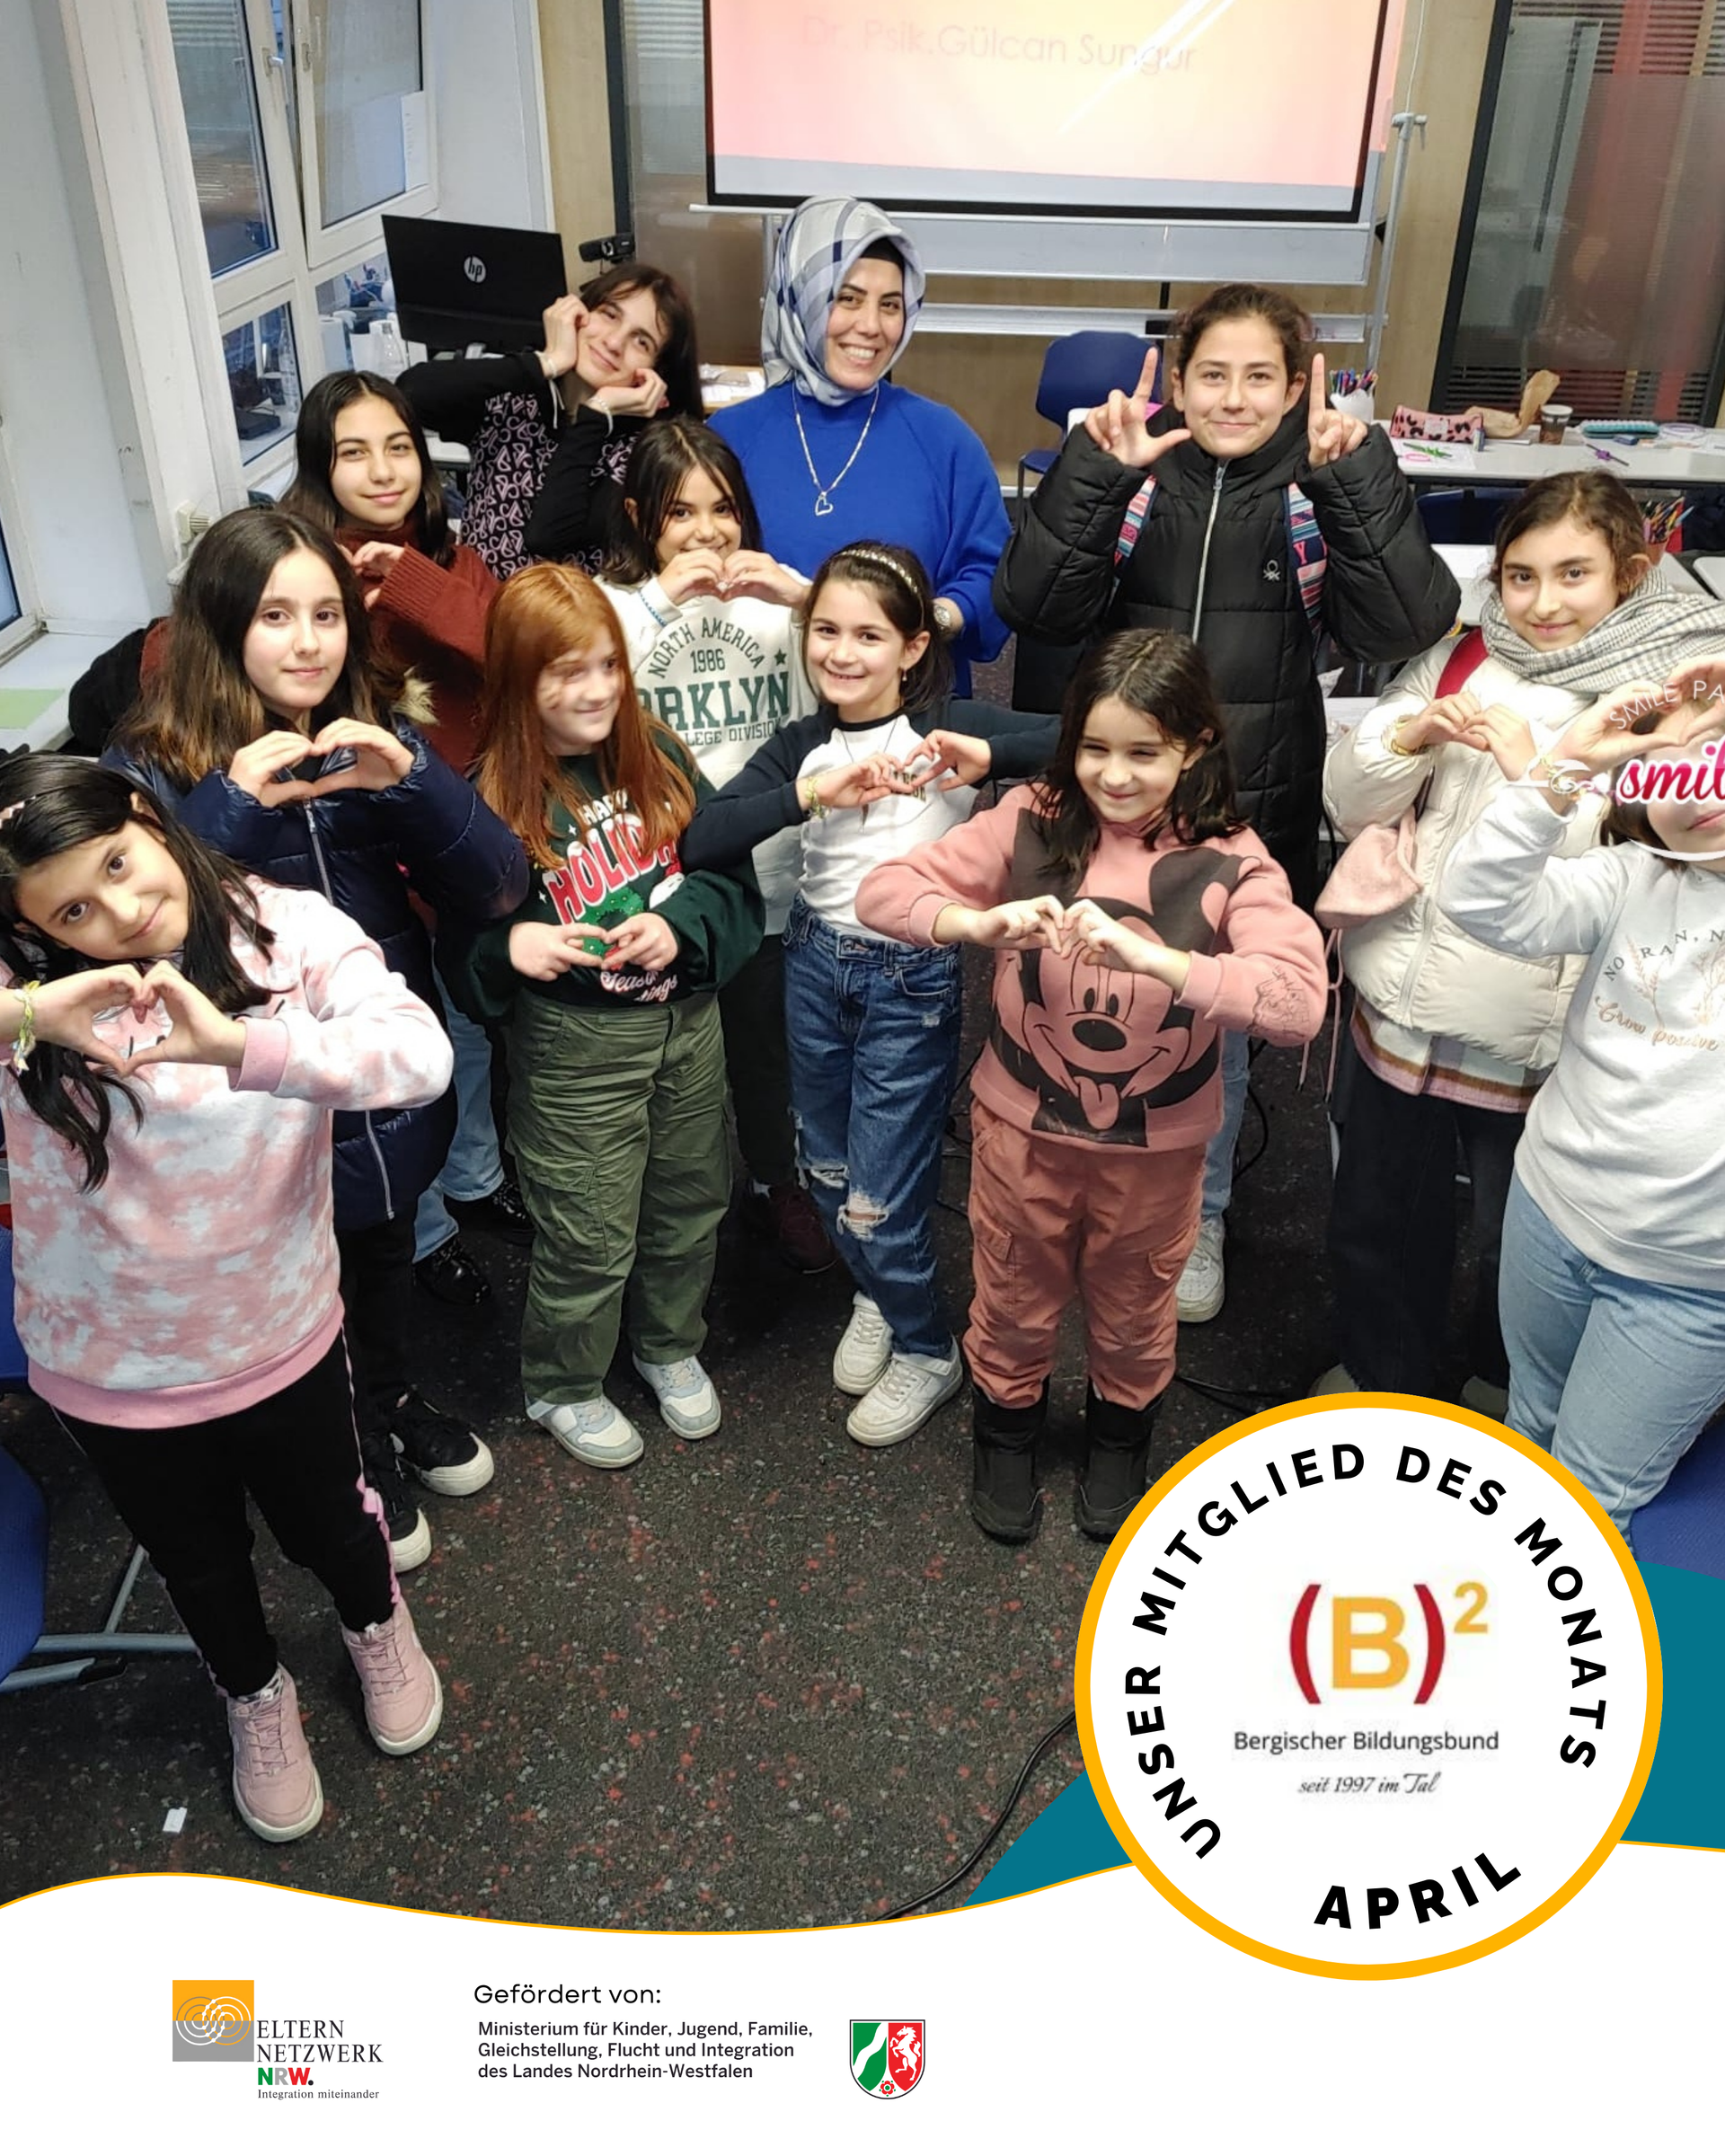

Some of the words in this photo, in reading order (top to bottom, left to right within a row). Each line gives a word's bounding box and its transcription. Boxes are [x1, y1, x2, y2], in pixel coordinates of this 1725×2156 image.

[464, 255, 487, 283] hp
[648, 623, 695, 679] NORTH
[702, 616, 765, 669] AMERICA
[690, 648, 726, 674] 1986
[685, 729, 722, 747] LEGE
[1604, 956, 1624, 982] NO
